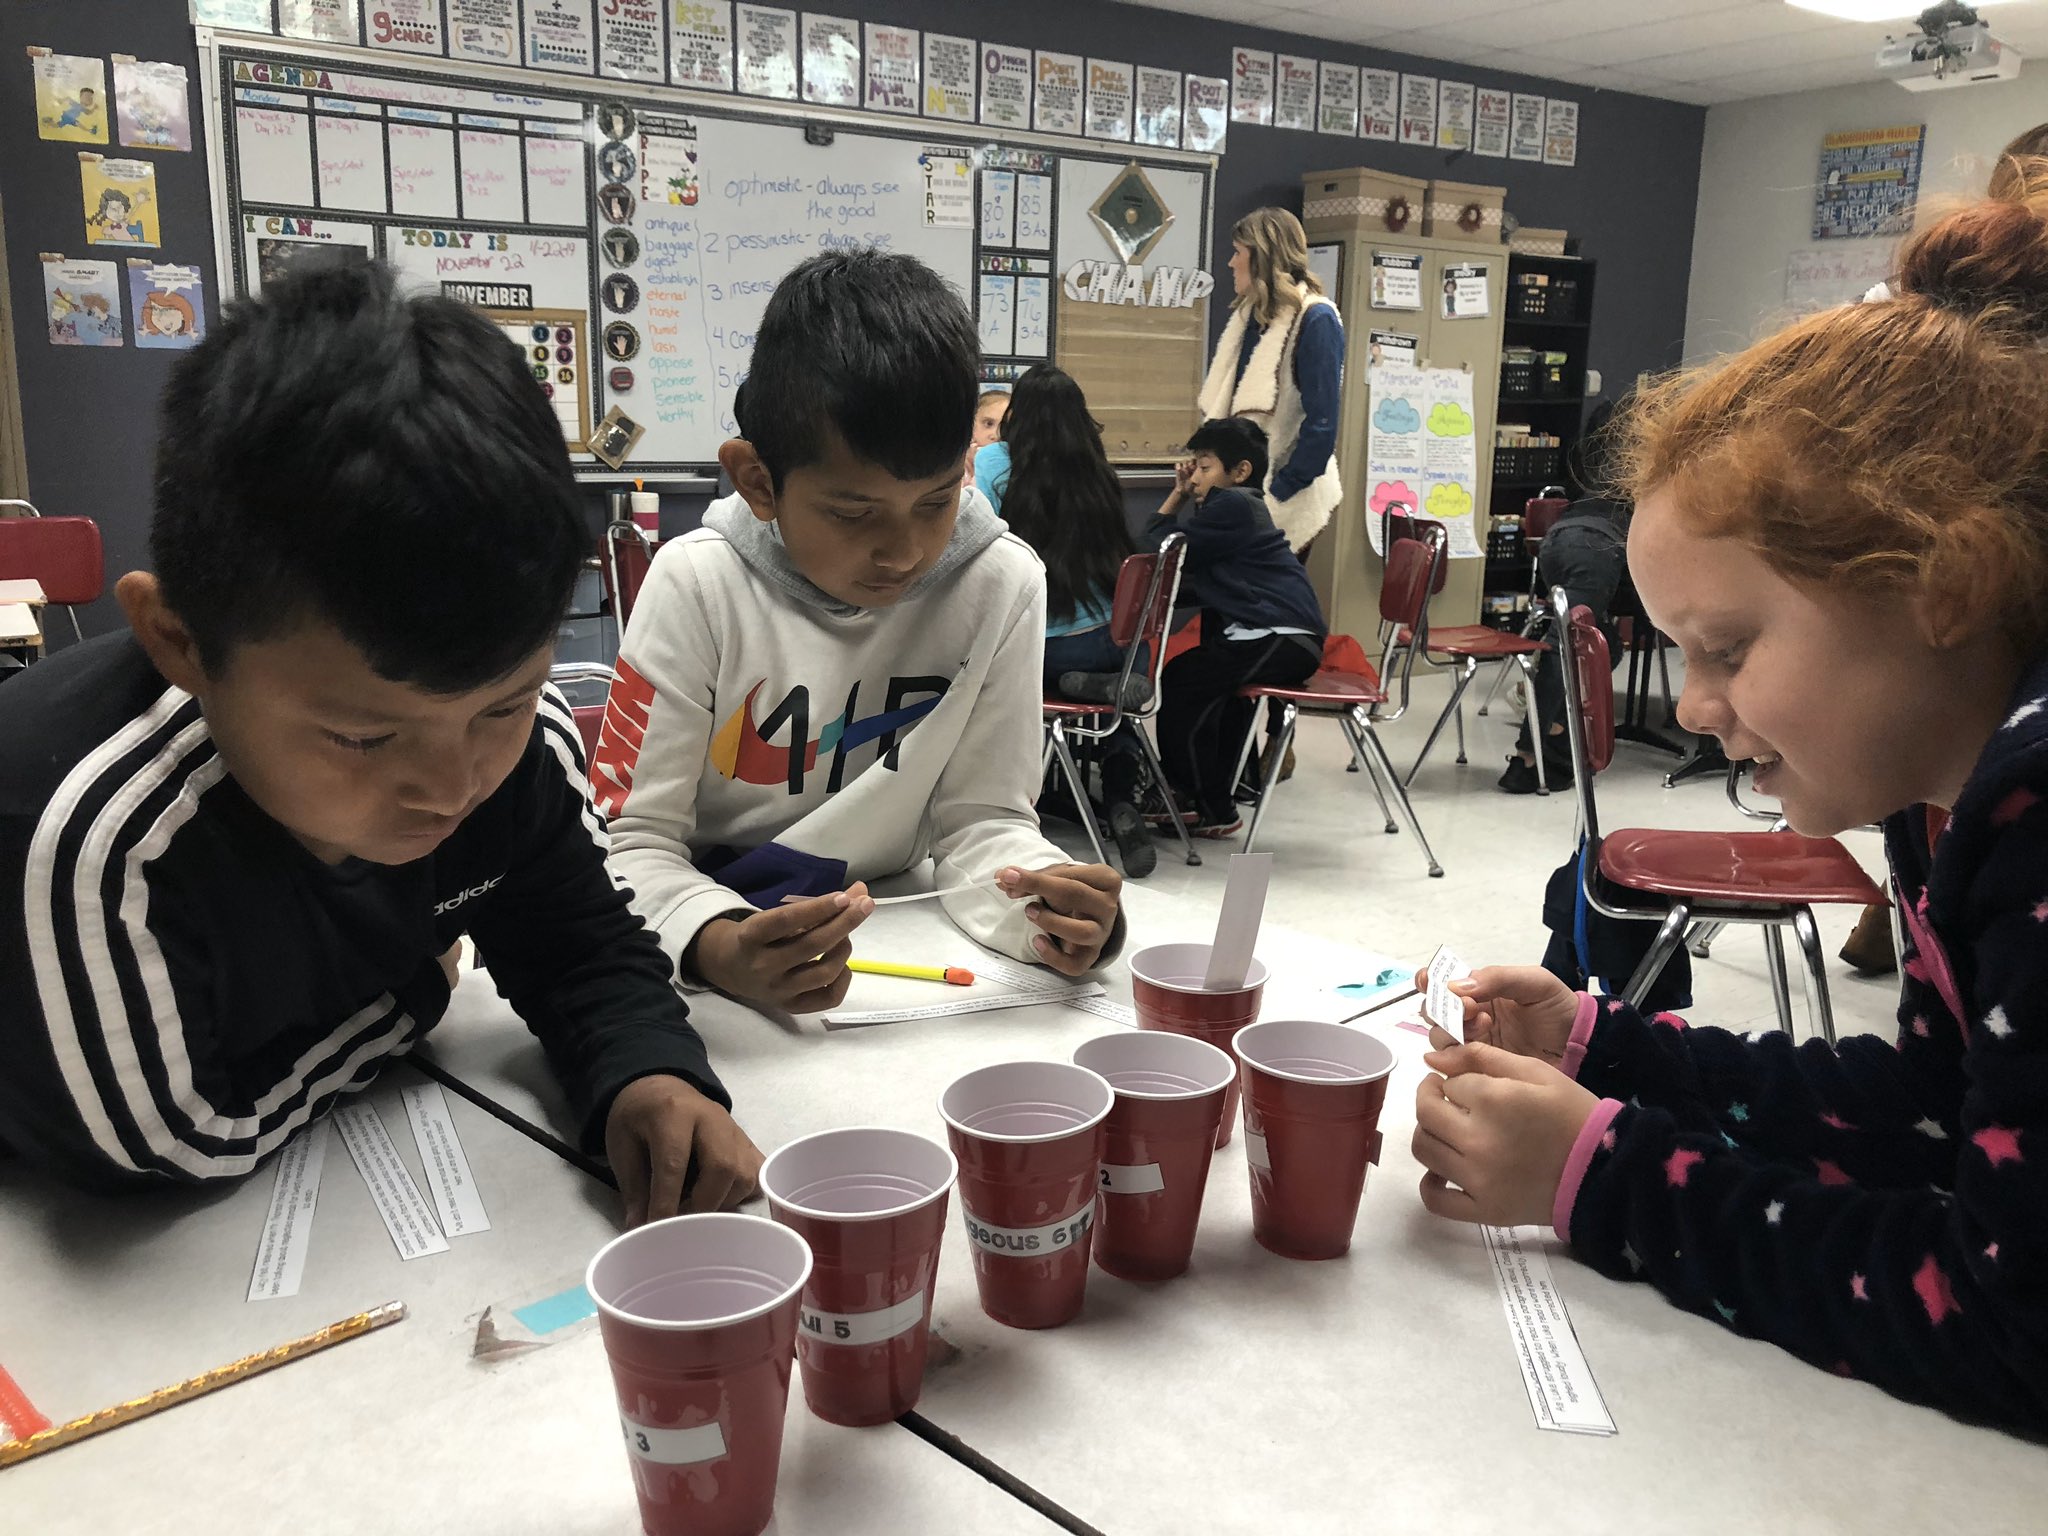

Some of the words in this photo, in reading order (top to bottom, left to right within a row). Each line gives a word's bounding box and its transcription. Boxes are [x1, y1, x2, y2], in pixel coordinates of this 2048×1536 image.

[236, 62, 333, 91] AGENDA
[242, 88, 281, 104] Monday
[724, 169, 803, 208] optimistic
[816, 175, 867, 199] always
[872, 181, 900, 194] see
[807, 200, 832, 220] the
[838, 201, 876, 226] good
[983, 202, 1004, 223] 80
[1021, 195, 1041, 215] 85
[245, 215, 256, 233] I
[645, 219, 691, 236] antique
[402, 228, 474, 249] TODAY
[487, 234, 508, 252] IS
[645, 236, 695, 257] baggage
[704, 233, 719, 254] 2
[727, 231, 805, 264] pessimistic
[436, 254, 494, 275] November
[500, 255, 525, 271] 22
[645, 255, 678, 273] digest
[648, 273, 698, 286] establish
[1064, 259, 1215, 308] CHAMP
[445, 285, 530, 307] NOVEMBER
[647, 290, 688, 302] eternal
[707, 284, 723, 301] 3
[649, 306, 681, 318] haste
[982, 293, 1009, 313] 73
[1019, 299, 1041, 321] 76
[648, 322, 679, 335] humid
[713, 326, 724, 349] 4
[652, 340, 678, 353] lash
[649, 357, 694, 373] oppose
[653, 375, 698, 393] pioneer
[718, 366, 731, 389] 5
[656, 392, 705, 406] sensible
[657, 409, 695, 424] worthy
[590, 655, 656, 818] NIKE
[1101, 1169, 1112, 1187] 2
[1052, 1227, 1067, 1244] 6
[1512, 1283, 1529, 1314] paragraph
[1541, 1289, 1560, 1321] corrected
[1523, 1314, 1533, 1326] the
[1535, 1308, 1546, 1323] read
[834, 1320, 851, 1339] 5
[1527, 1325, 1539, 1342] read
[1540, 1323, 1553, 1340] Luke
[1548, 1383, 1561, 1401] Luke
[636, 1432, 651, 1453] 3
